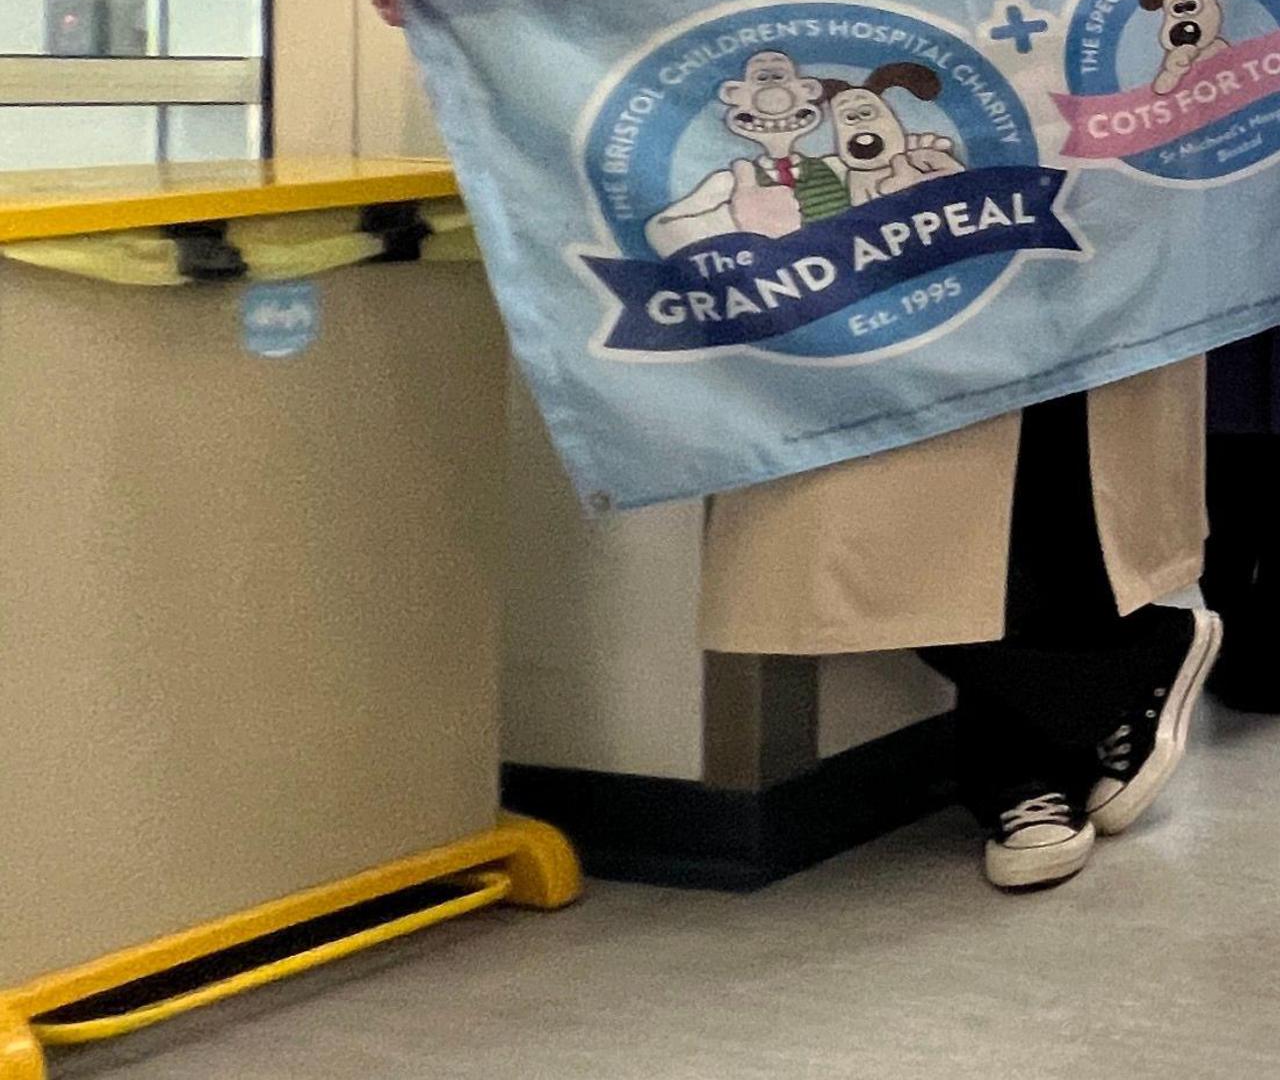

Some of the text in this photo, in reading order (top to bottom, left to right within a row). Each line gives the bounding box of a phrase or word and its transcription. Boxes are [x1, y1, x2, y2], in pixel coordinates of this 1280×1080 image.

[1079, 37, 1098, 75] THE
[602, 86, 665, 174] BRISTOL
[829, 19, 953, 69] HOSPITAL
[952, 64, 1021, 144] CHARITY
[1087, 100, 1172, 138] COTS
[1175, 70, 1241, 113] FOR
[646, 192, 1036, 327] GRAND APPEAL
[691, 247, 755, 280] The
[901, 277, 963, 317] 1995
